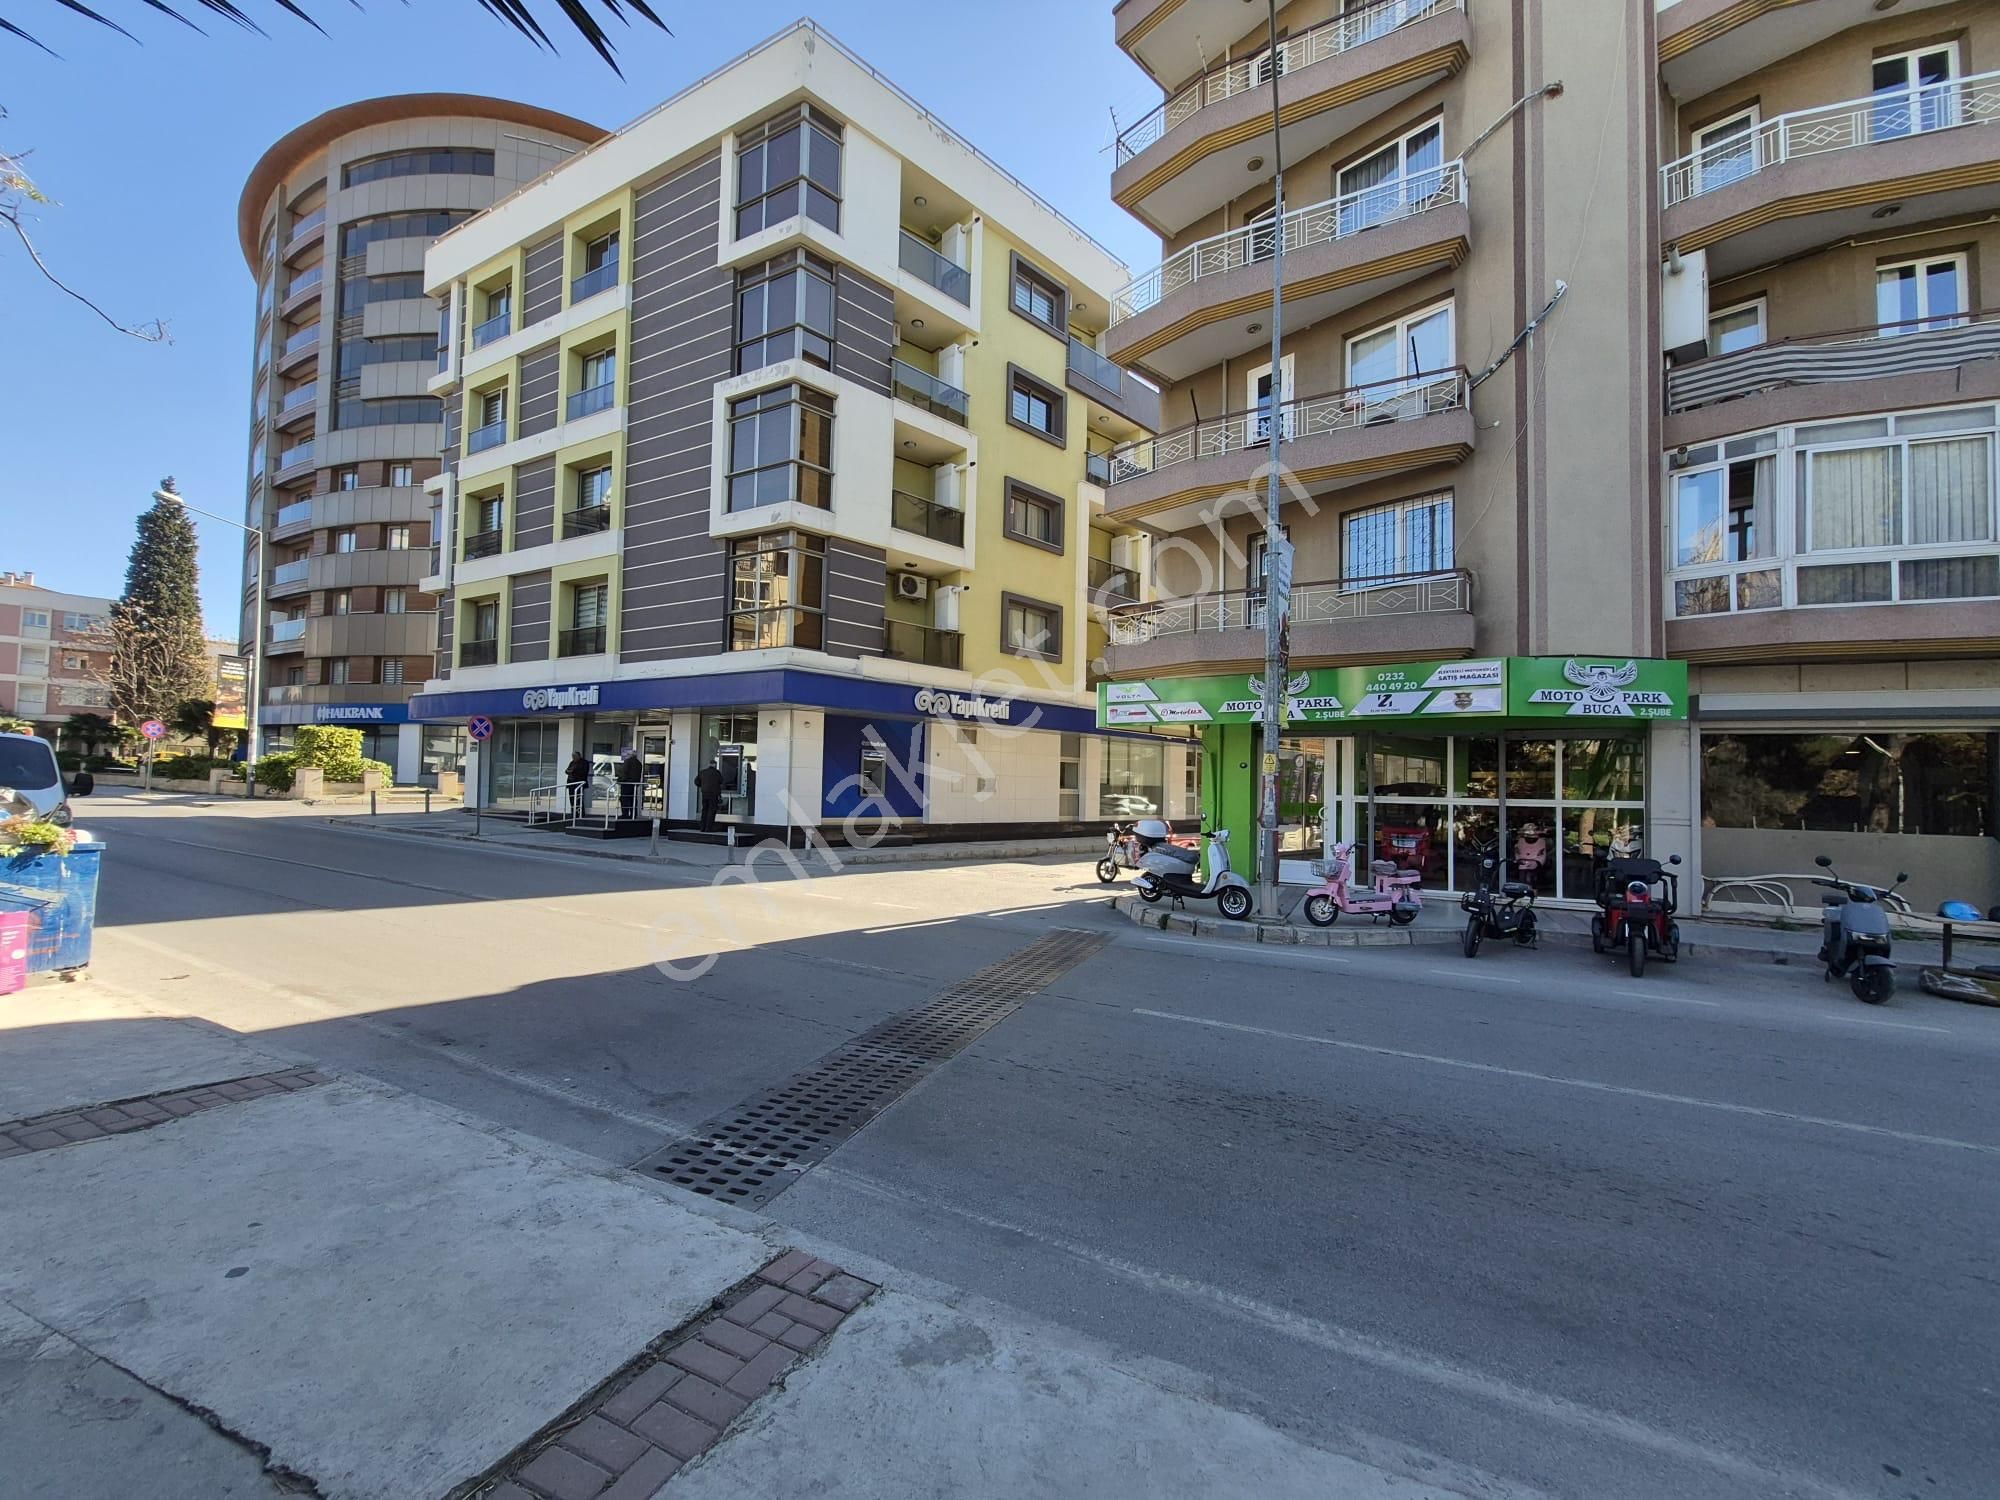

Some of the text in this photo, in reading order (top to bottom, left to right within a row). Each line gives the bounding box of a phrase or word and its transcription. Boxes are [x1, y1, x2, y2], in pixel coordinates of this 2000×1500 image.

[1377, 672, 1405, 681] 0232
[1460, 672, 1499, 680] MAĞAZASI
[1366, 681, 1418, 692] 440 49 20
[1541, 690, 1662, 703] MOTO PARK
[1226, 698, 1333, 711] MOTO PARK
[1583, 704, 1621, 714] BUCA
[327, 707, 384, 719] HALKBANK
